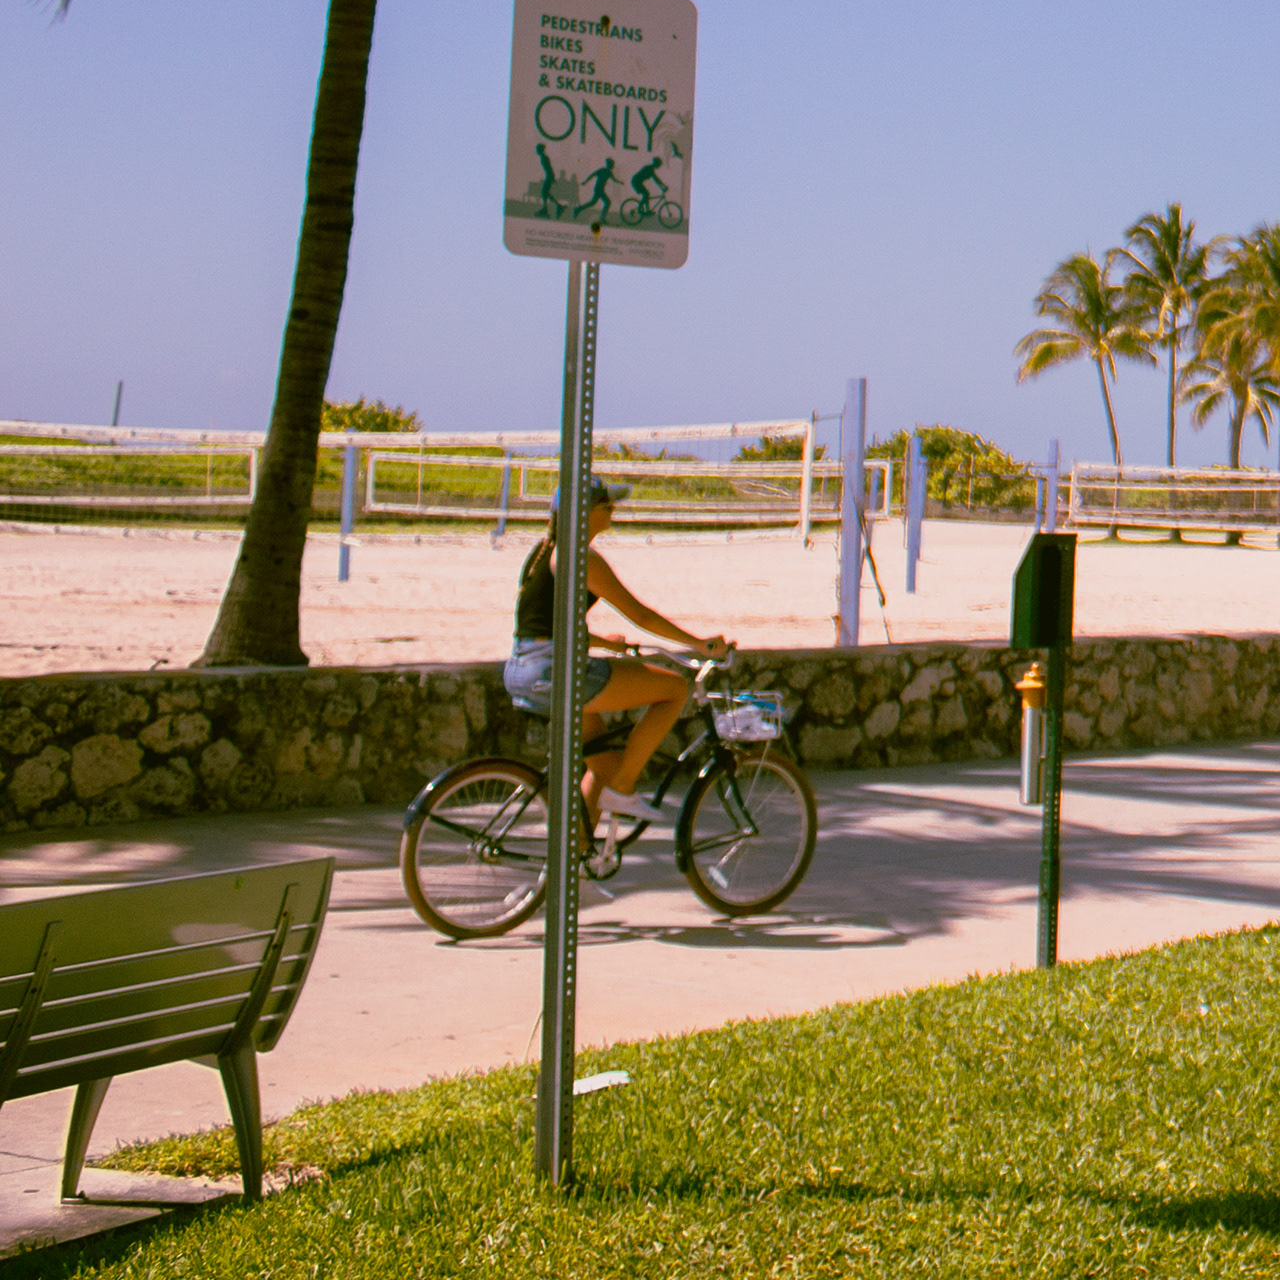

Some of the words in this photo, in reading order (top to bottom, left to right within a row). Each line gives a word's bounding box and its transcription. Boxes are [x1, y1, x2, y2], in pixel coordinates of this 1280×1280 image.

[541, 14, 643, 42] PEDESTRIANS
[540, 34, 583, 53] BIKES
[539, 54, 595, 75] SKATES
[538, 73, 550, 88] &
[556, 75, 667, 103] SKATEBOARDS
[534, 95, 666, 153] ONLY
